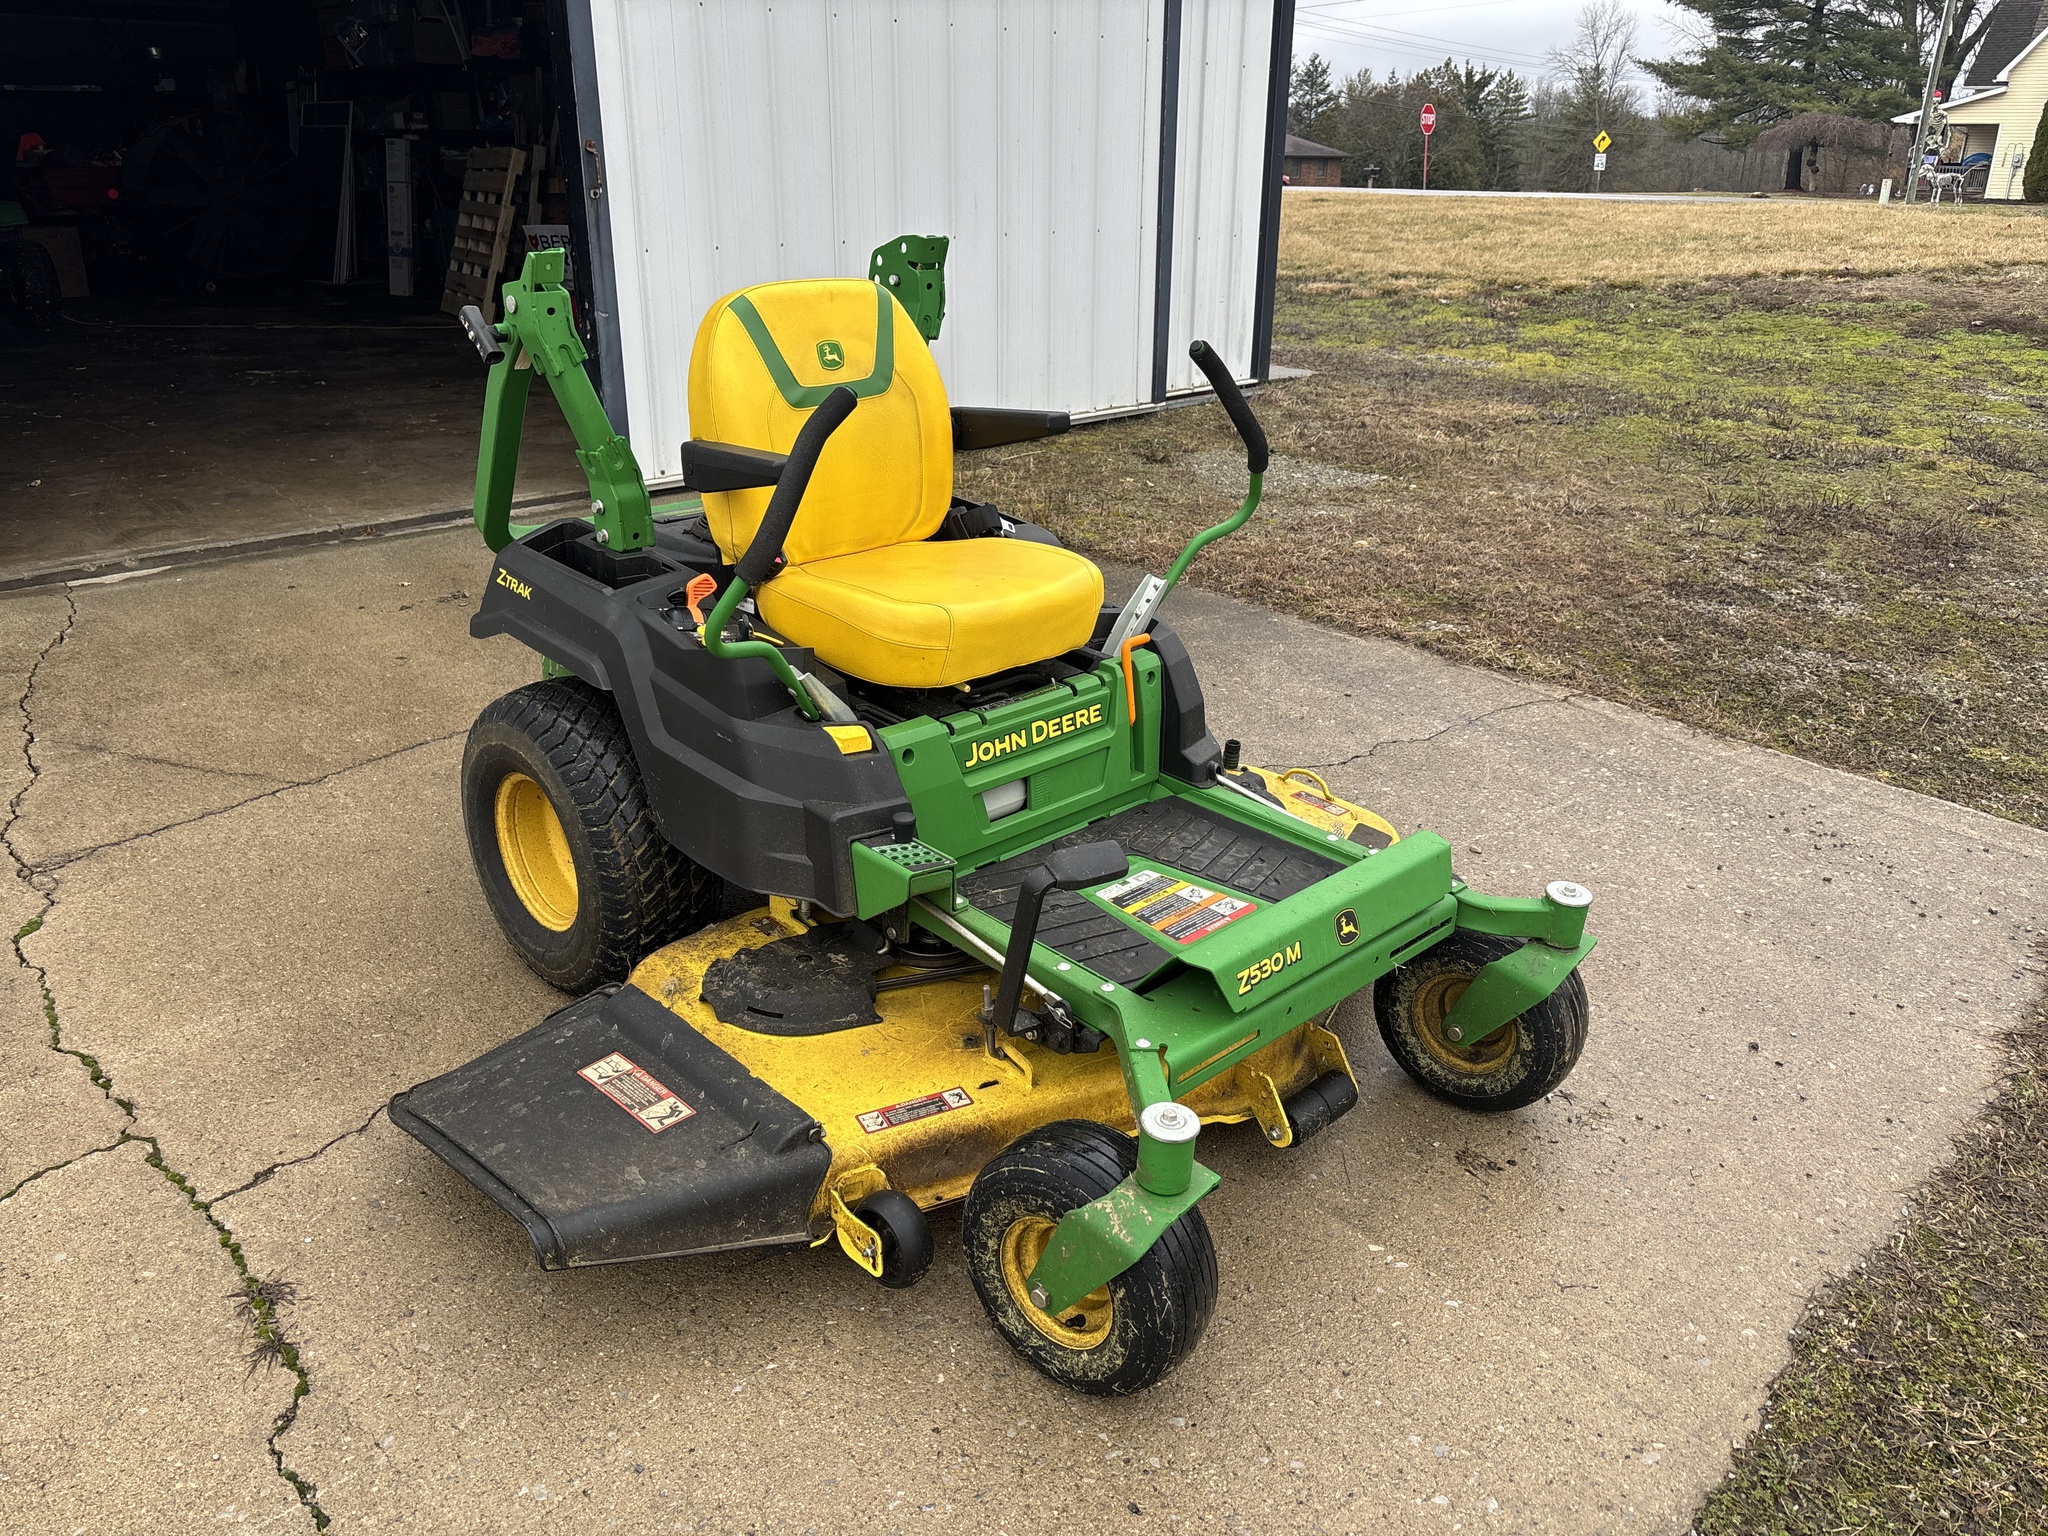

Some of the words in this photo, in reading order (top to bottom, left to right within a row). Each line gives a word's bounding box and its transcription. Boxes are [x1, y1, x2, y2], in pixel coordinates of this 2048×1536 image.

[1421, 113, 1435, 125] STOP
[965, 729, 1028, 768] JOHN
[1031, 703, 1103, 744] DEERE
[1237, 952, 1285, 997] Z530
[1286, 940, 1303, 967] M
[641, 1075, 668, 1096] DANGER
[899, 1096, 928, 1107] DANGER
